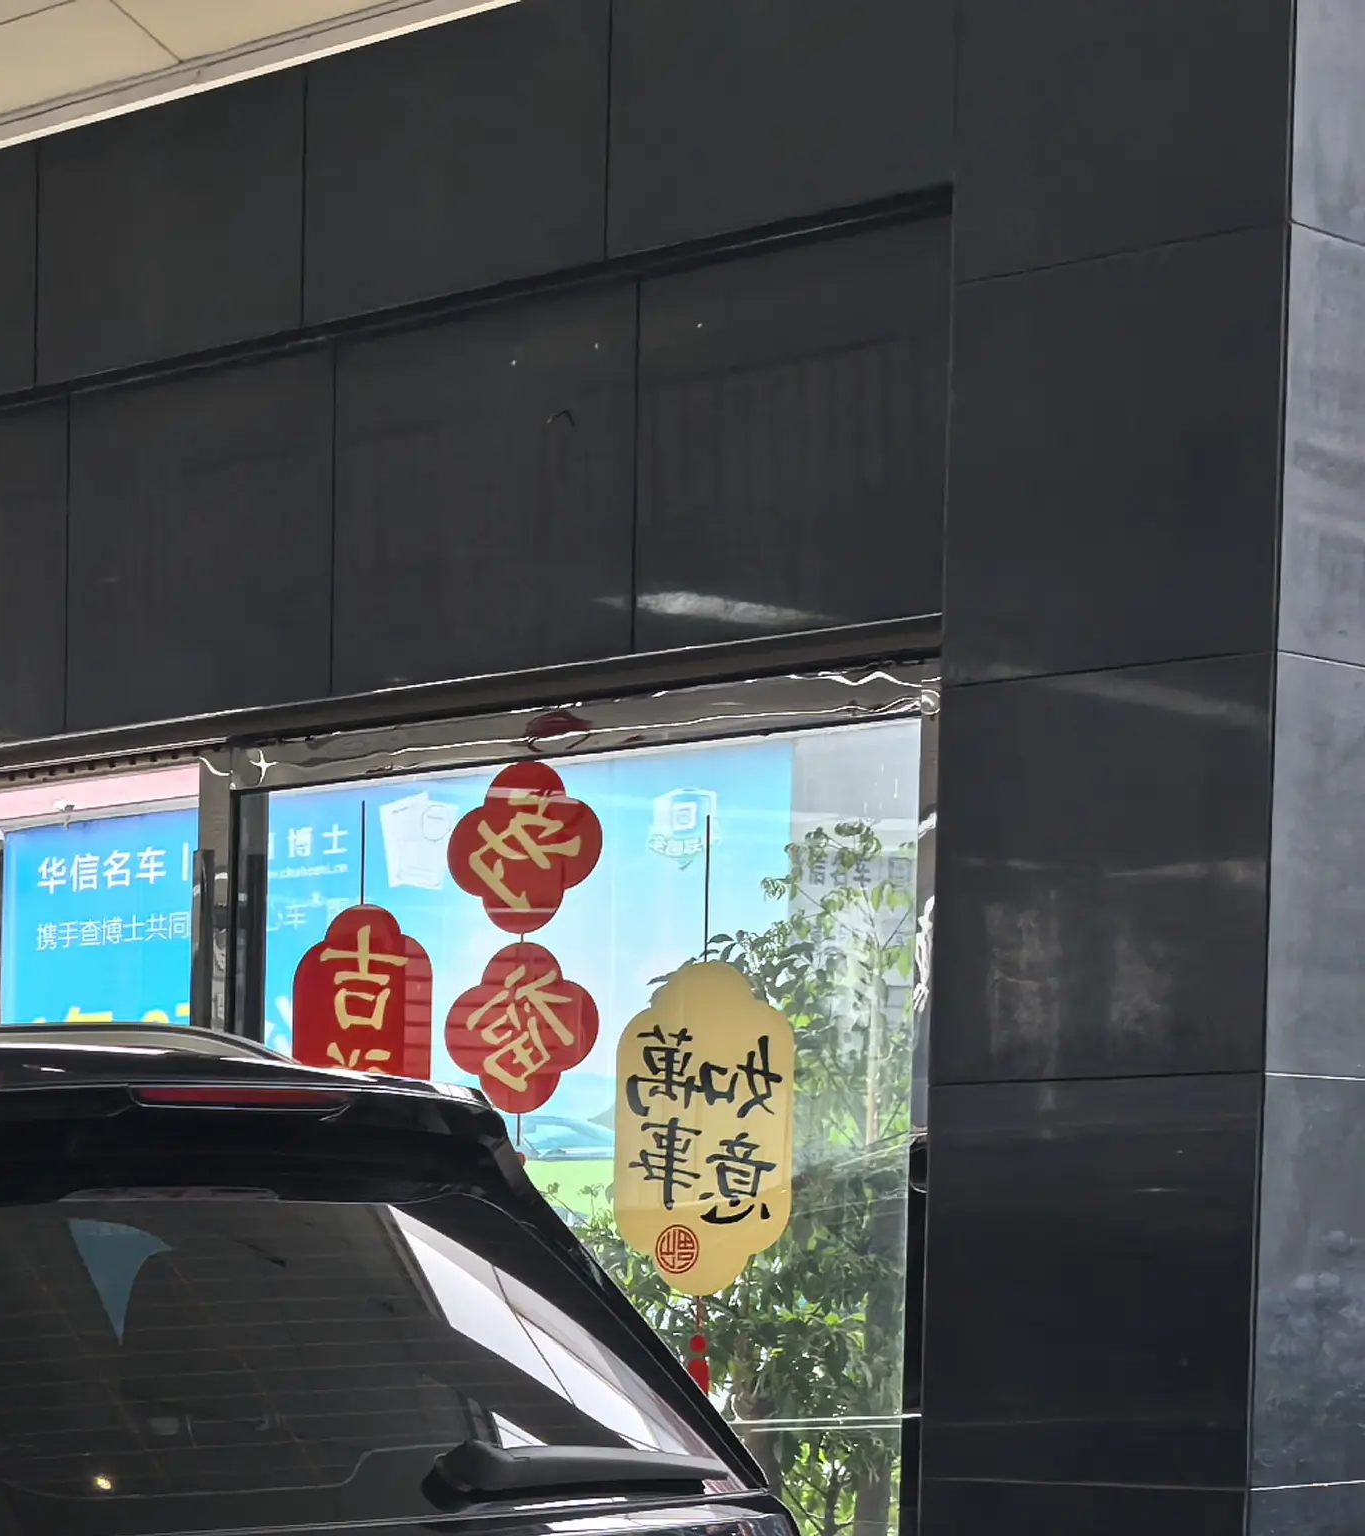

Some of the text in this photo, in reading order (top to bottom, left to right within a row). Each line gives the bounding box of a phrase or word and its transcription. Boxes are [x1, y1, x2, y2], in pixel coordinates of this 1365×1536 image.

[37, 824, 348, 894] 华信名车 博士
[36, 911, 191, 951] 携手查博士共同
